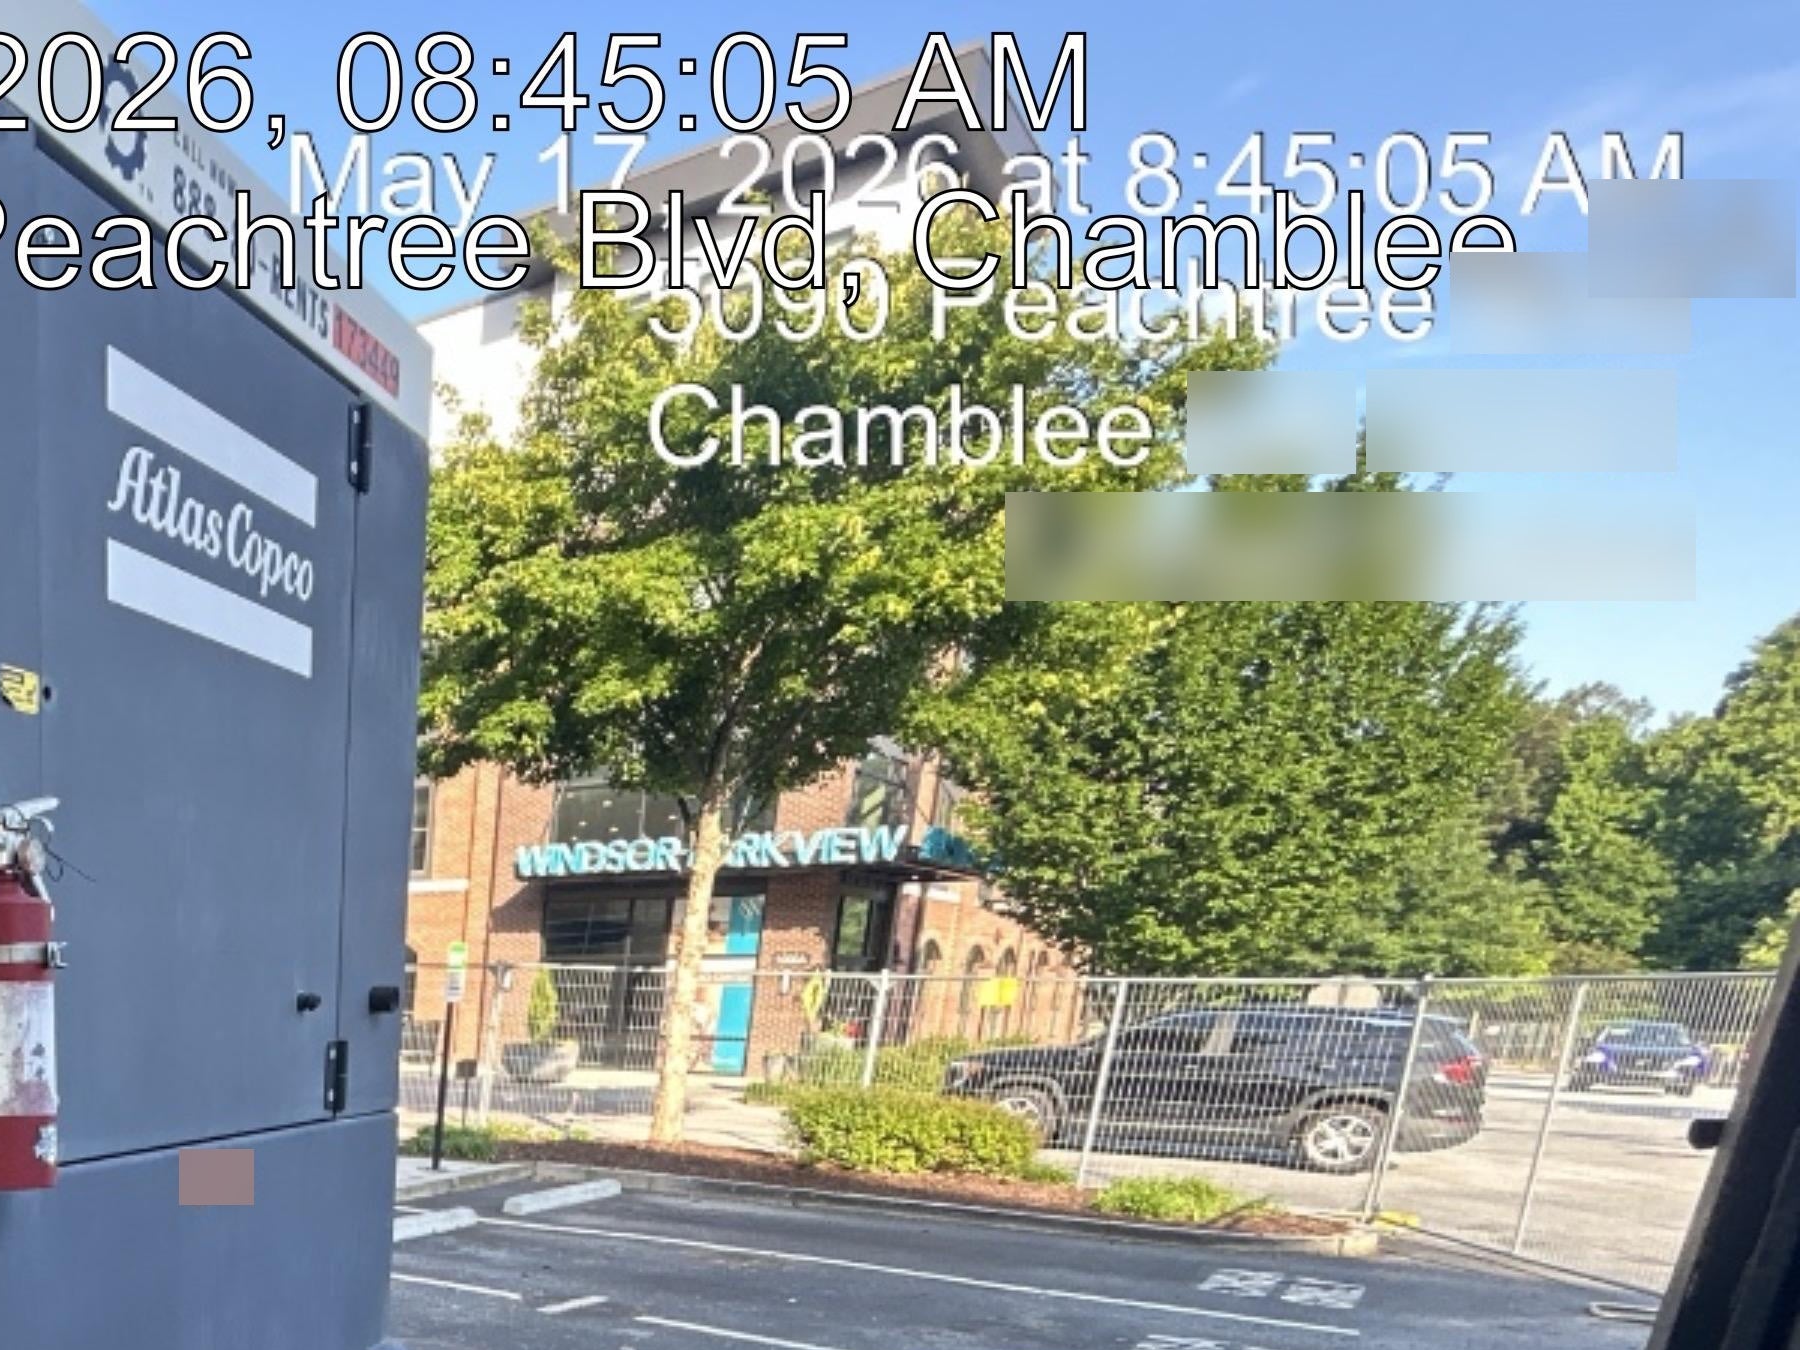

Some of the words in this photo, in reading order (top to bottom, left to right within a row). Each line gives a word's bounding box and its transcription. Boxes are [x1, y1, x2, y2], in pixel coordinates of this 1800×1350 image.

[107, 446, 223, 559] Atlas
[226, 502, 314, 602] Copco
[514, 835, 682, 877] WINDSOR
